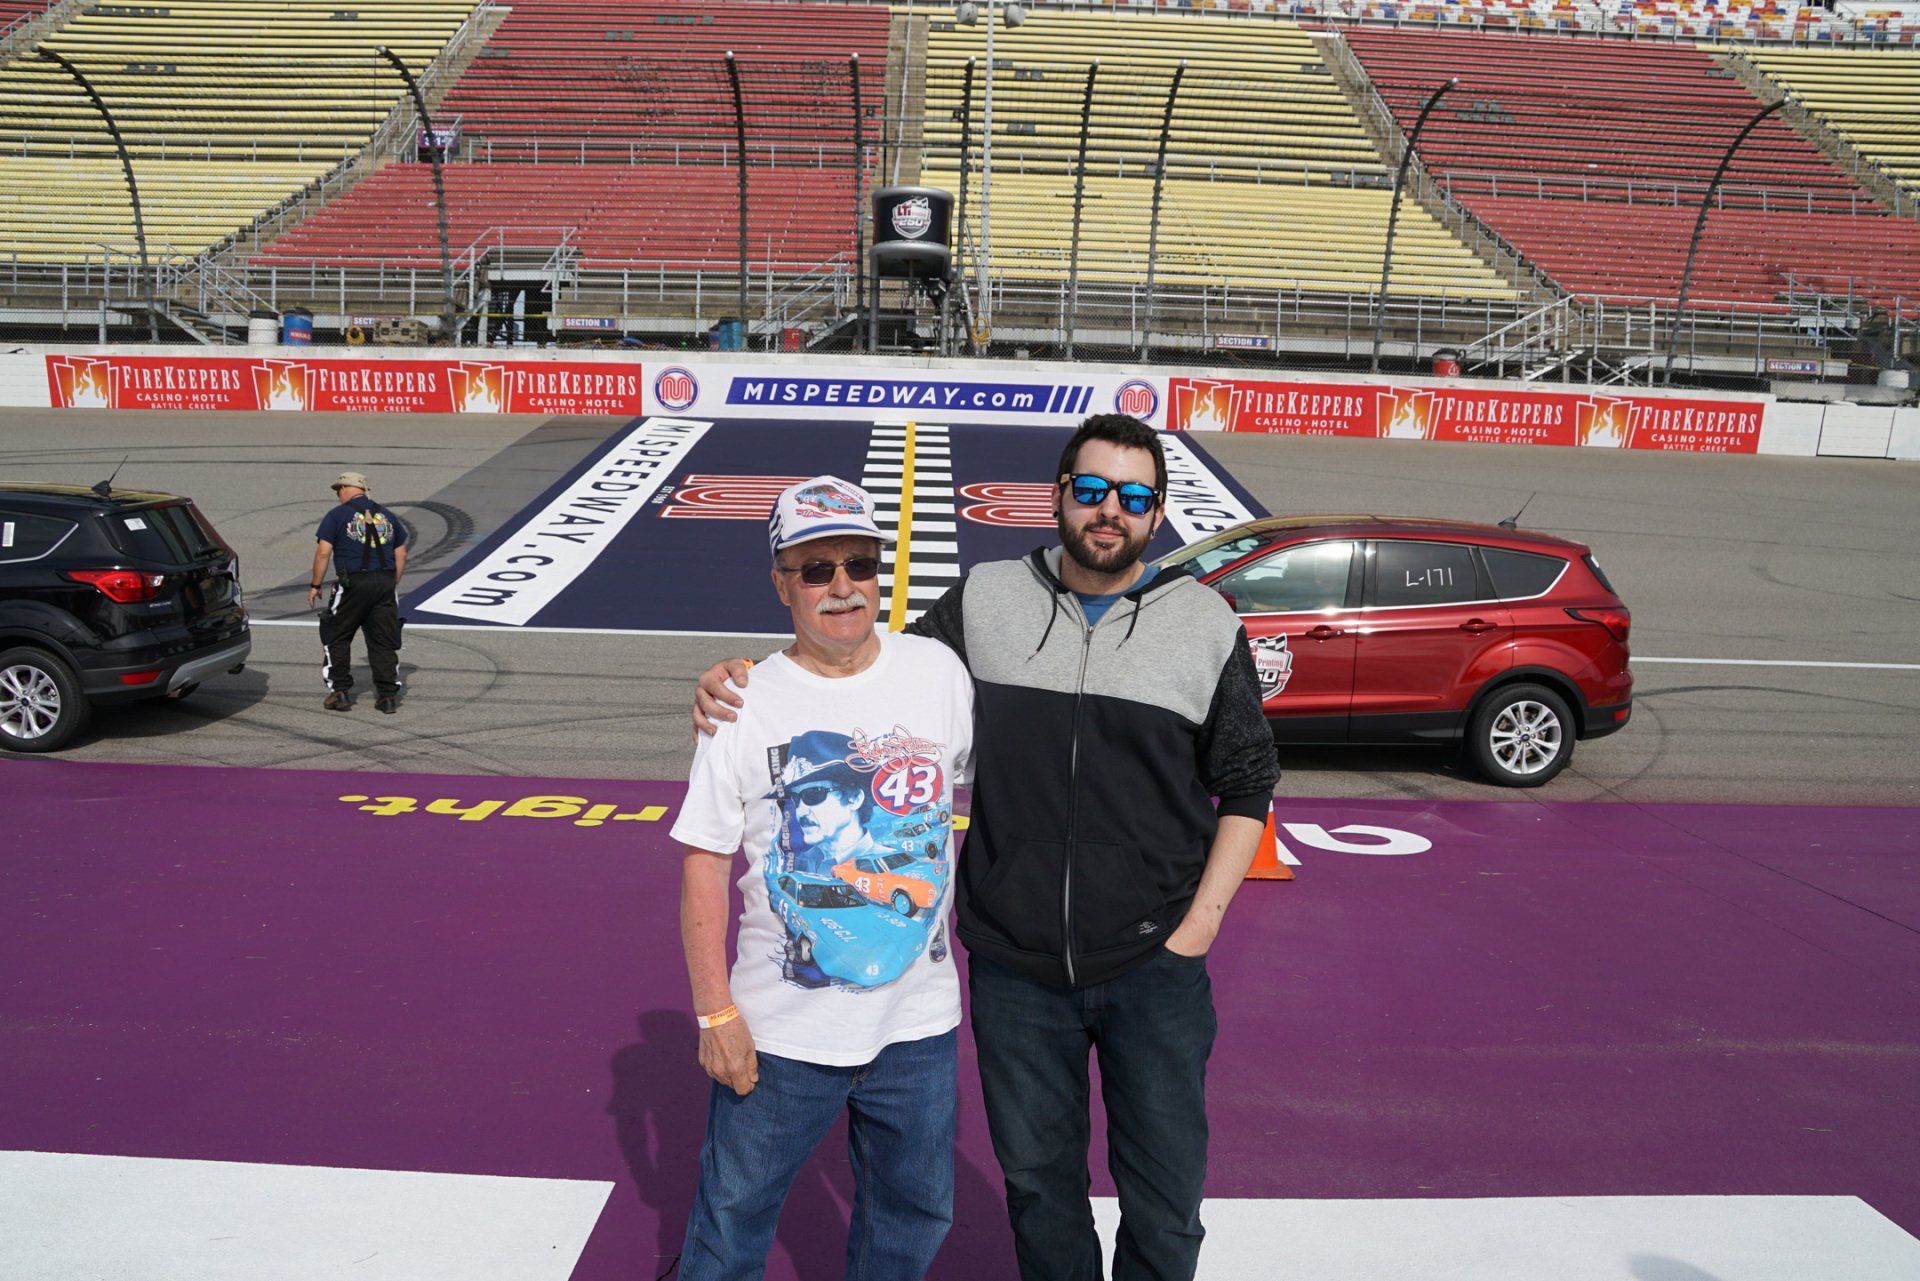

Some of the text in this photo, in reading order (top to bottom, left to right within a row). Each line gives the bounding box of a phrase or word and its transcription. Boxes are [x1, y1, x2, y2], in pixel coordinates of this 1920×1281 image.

[353, 317, 373, 325] SECT
[566, 318, 609, 327] SECTION 1
[1218, 337, 1262, 347] SECTION 2
[1770, 362, 1811, 371] SECTION 4
[122, 365, 240, 390] FIREKEEPERS
[318, 368, 436, 393] FIREKEEPERS
[516, 370, 636, 396] FIREKEEPERS
[136, 393, 230, 402] CASINO HOTEL
[332, 395, 425, 405] CASINO HOTEL
[744, 382, 1034, 408] MISPEEDWAY.com
[529, 397, 624, 408] CASINO HOTEL
[1244, 389, 1364, 417] FIREKEEPERS
[1444, 397, 1563, 425] FIREKEEPERS
[1255, 417, 1349, 429] CASINO HOTEL
[1642, 406, 1757, 434] FIREKEEPERS
[1306, 428, 1335, 436] CREEK
[1455, 425, 1549, 437] CASINO HOTEL
[1467, 435, 1534, 444] BATTLE CREEK
[1651, 433, 1742, 446] CASINO HOTEL
[1663, 444, 1694, 452] BATTLE
[451, 423, 696, 607] MISPEEDWAY.com
[1406, 567, 1453, 587] L-171
[1258, 659, 1284, 668] Printing
[770, 747, 781, 775] KING
[879, 765, 937, 807] 43
[339, 795, 669, 827] right.
[781, 811, 792, 848] LEGEND
[901, 840, 914, 852] 43
[855, 878, 871, 893] 43
[866, 965, 879, 976] 43
